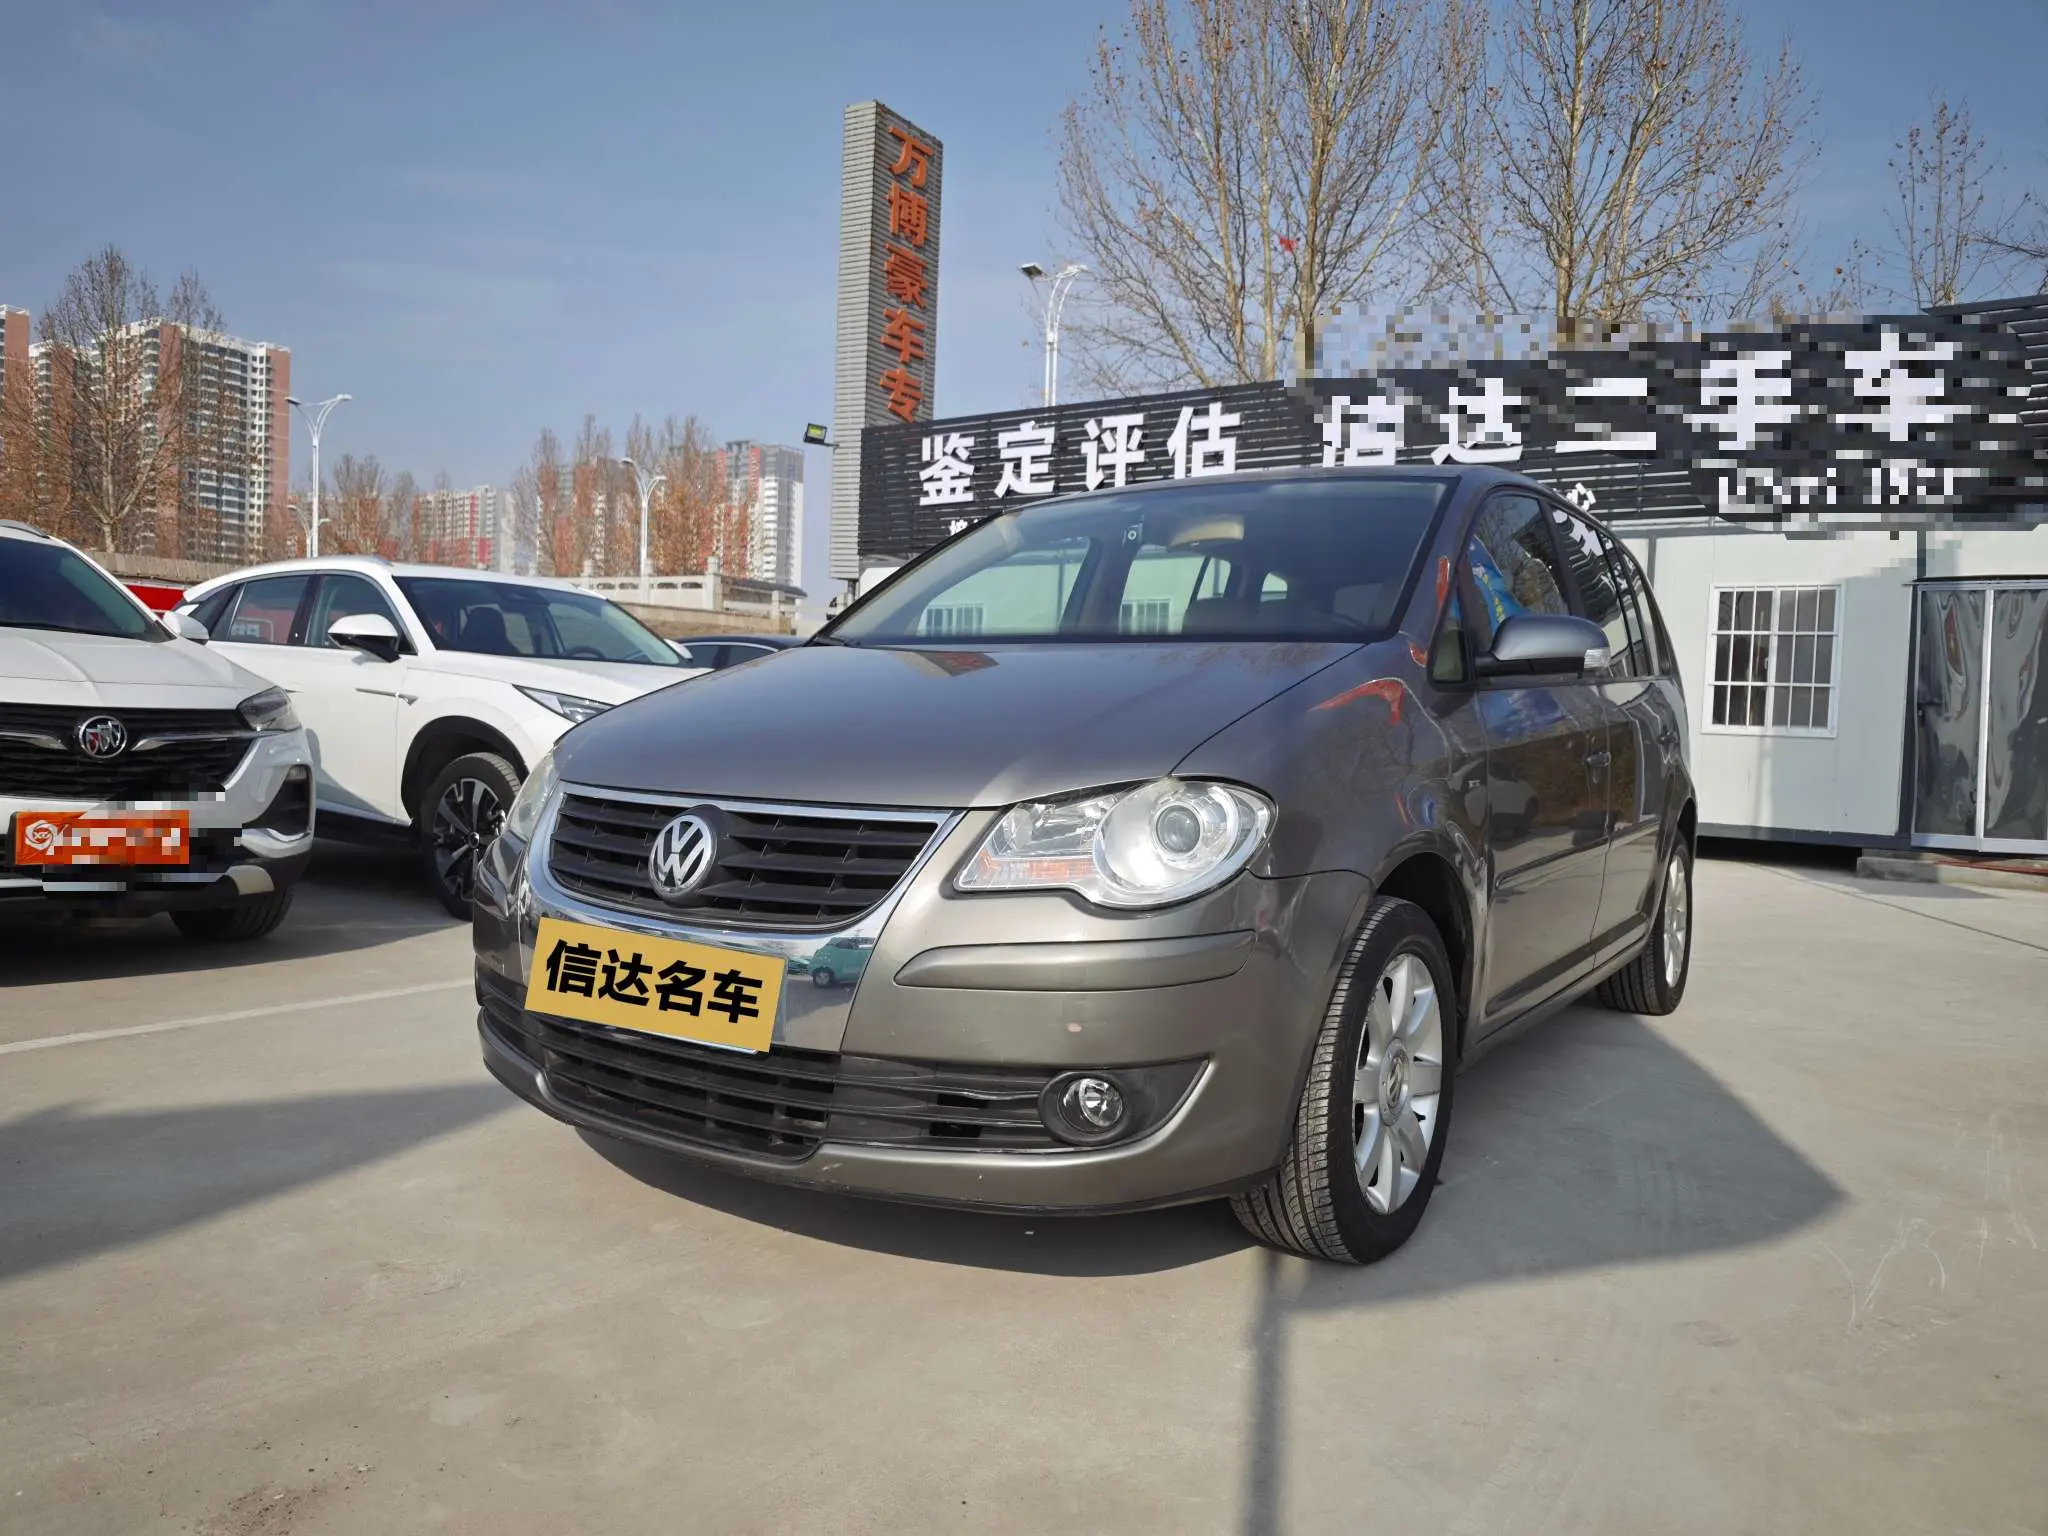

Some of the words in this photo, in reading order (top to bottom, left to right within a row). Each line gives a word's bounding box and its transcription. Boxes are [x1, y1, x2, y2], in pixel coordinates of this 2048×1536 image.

[881, 126, 933, 423] 万博豪车专
[919, 401, 1241, 506] 鉴定评估
